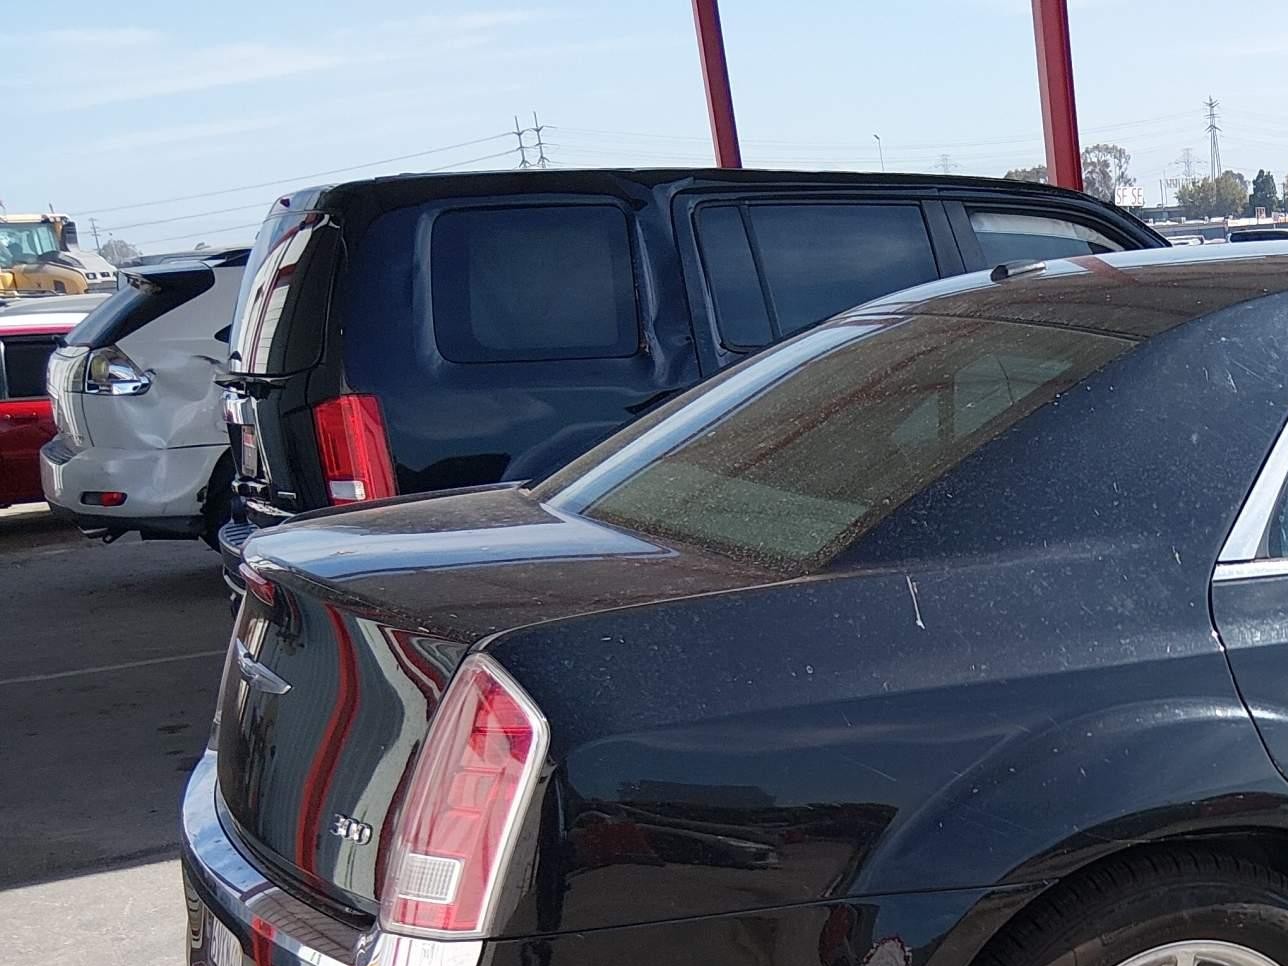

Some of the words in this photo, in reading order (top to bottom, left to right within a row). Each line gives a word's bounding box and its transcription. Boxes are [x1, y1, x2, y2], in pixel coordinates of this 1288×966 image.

[1116, 187, 1128, 205] SF
[1131, 187, 1143, 205] SE
[329, 813, 372, 846] 300
